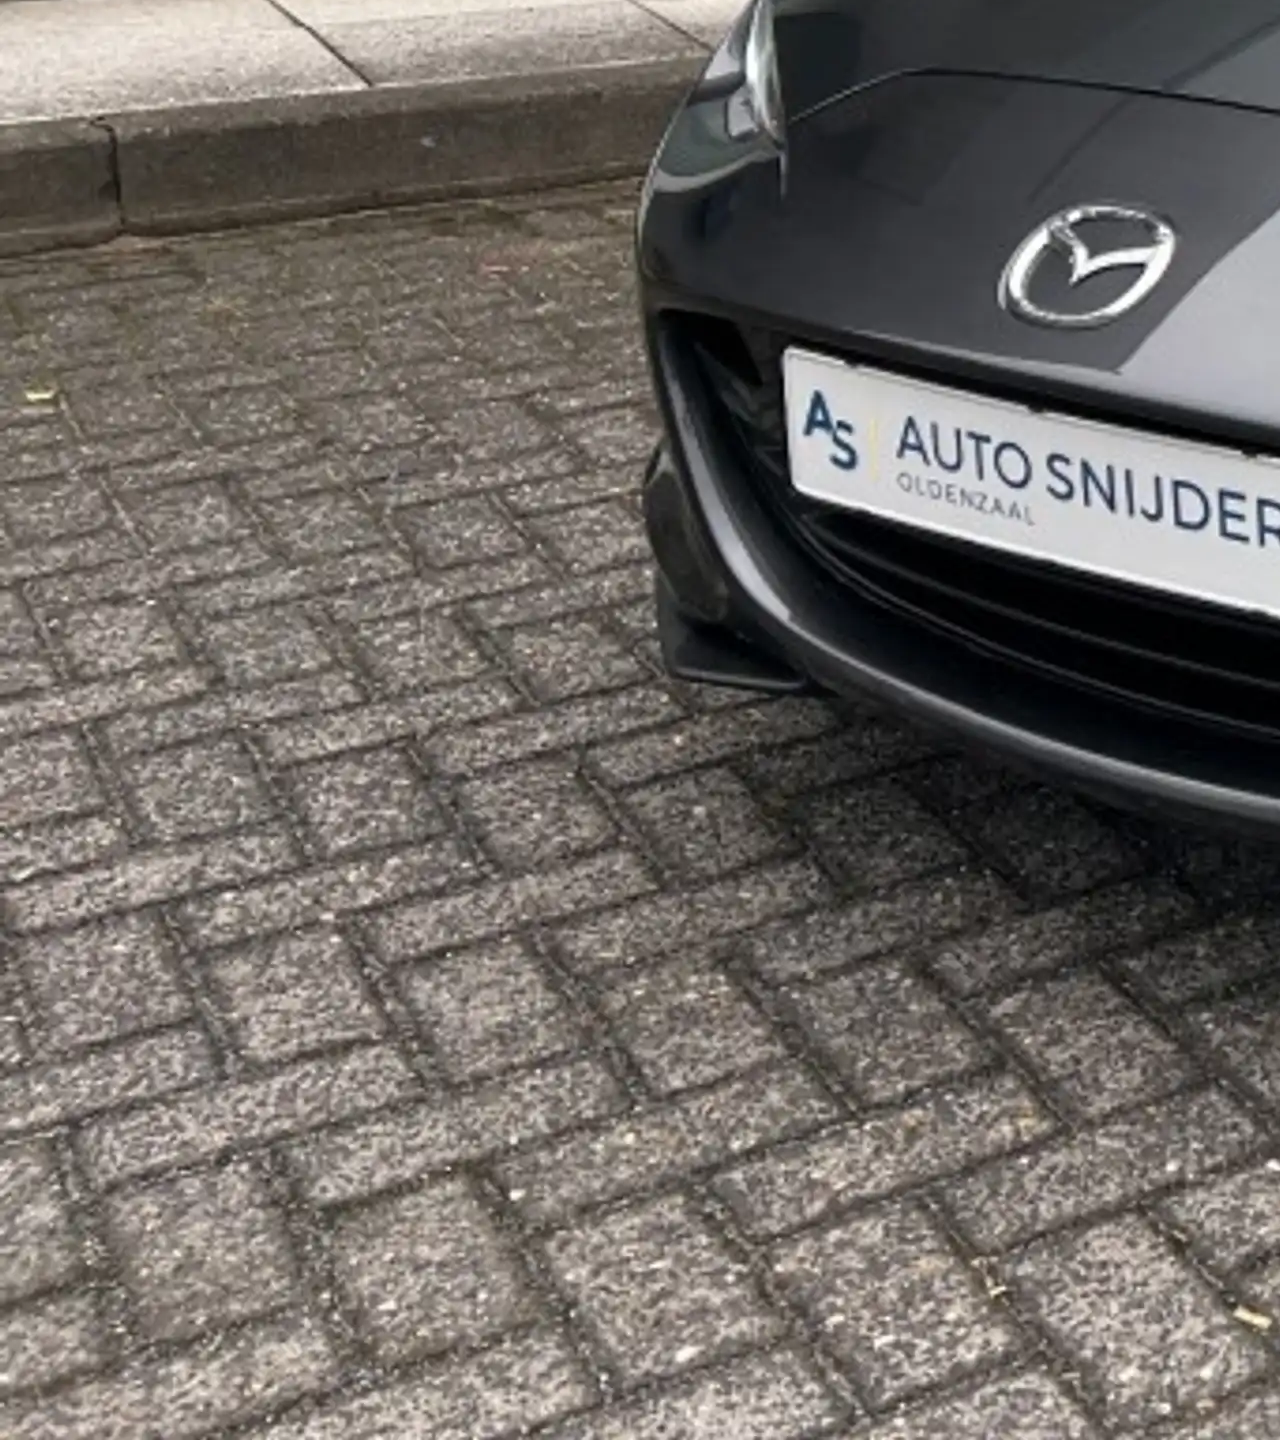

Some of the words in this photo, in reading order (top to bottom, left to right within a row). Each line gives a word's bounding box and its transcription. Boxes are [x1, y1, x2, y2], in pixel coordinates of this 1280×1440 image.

[803, 389, 859, 471] AS
[896, 415, 1033, 489] AUTO
[895, 471, 1036, 526] OLDENZAAL
